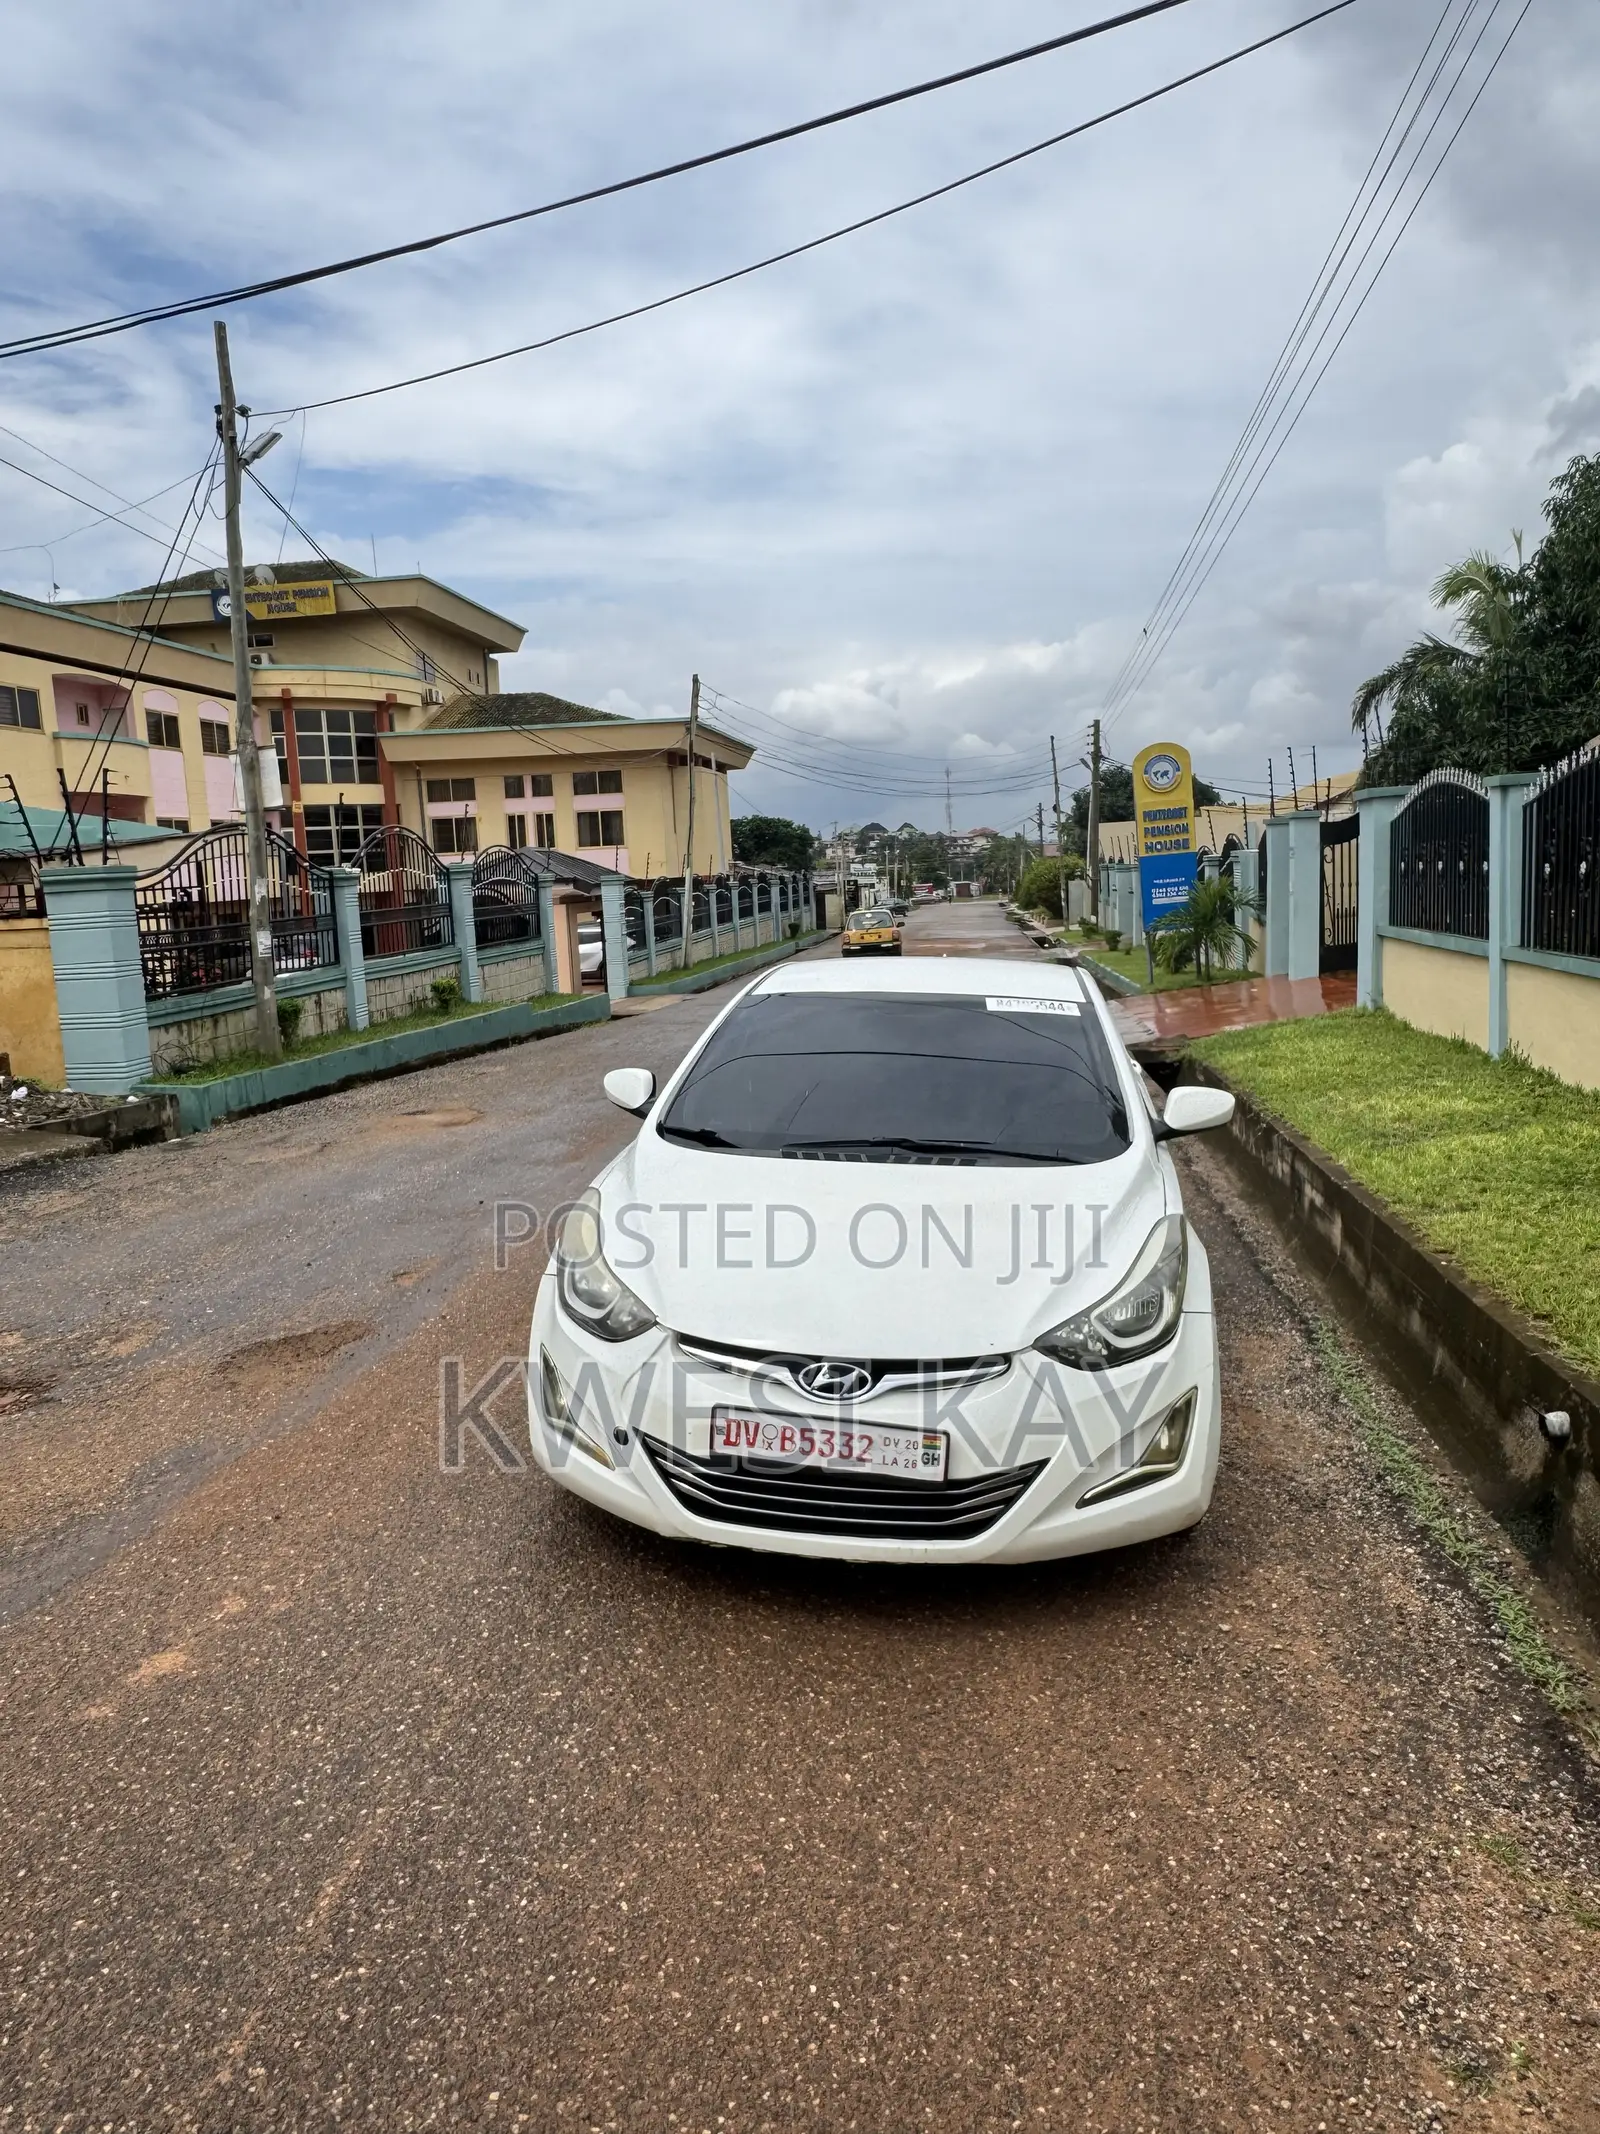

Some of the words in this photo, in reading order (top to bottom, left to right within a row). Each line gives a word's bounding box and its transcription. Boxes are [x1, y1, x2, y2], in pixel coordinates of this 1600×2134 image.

[244, 590, 290, 603] ENTECOST
[1144, 822, 1189, 838] PENSION
[1144, 838, 1190, 854] HOUSE
[723, 1418, 760, 1448] DV
[779, 1425, 874, 1463] B5332
[883, 1436, 900, 1448] DV
[905, 1440, 919, 1451] 20
[882, 1455, 899, 1467] LA
[904, 1458, 918, 1469] 26
[921, 1452, 941, 1467] GH
